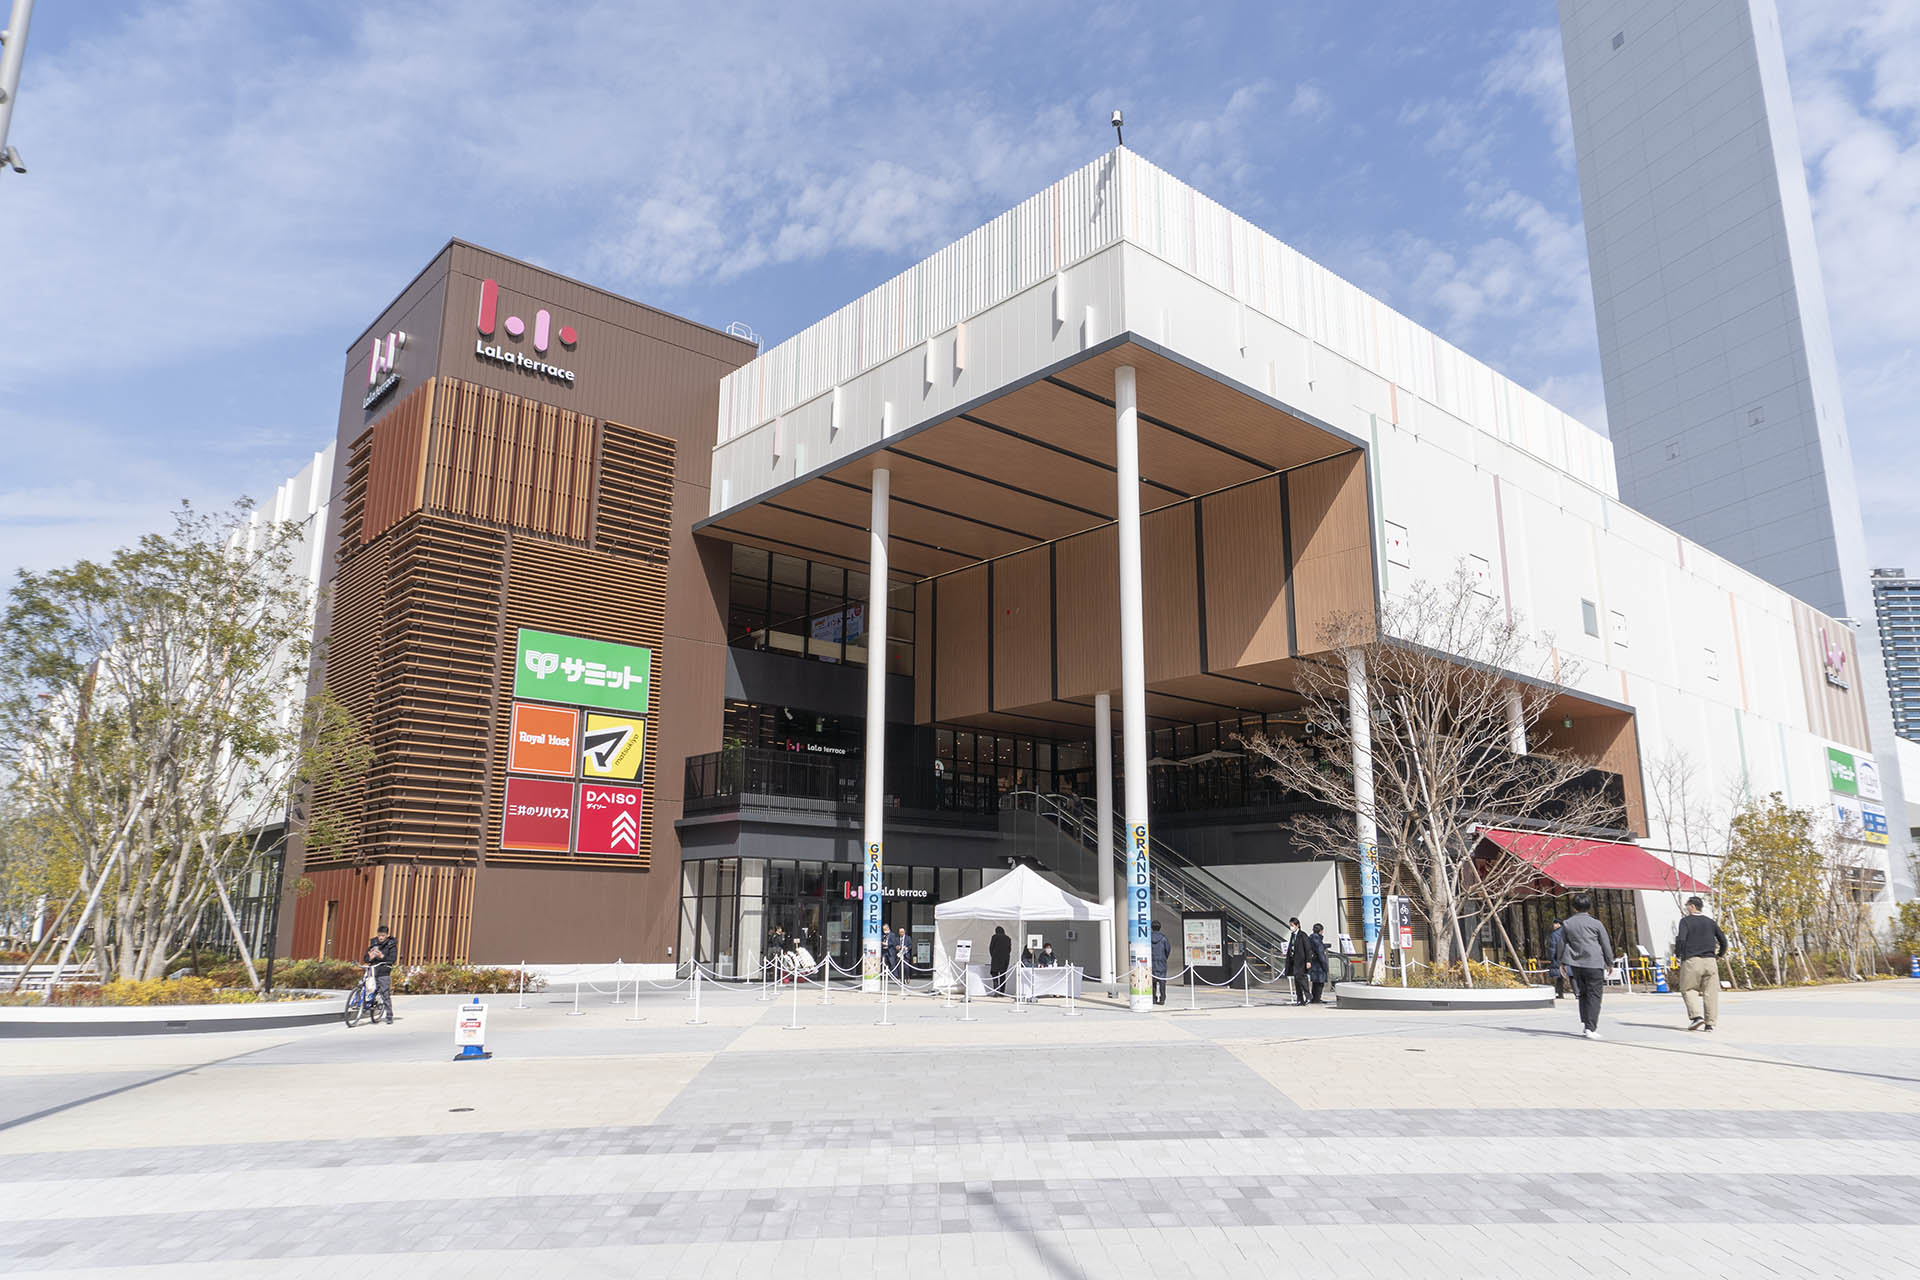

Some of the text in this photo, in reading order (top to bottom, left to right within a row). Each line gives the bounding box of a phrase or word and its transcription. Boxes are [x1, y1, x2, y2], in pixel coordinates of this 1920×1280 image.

[476, 340, 575, 381] LaLa terrace
[560, 656, 643, 690] サミット
[519, 731, 570, 747] Royal Host
[615, 734, 639, 766] matsukiyo
[807, 743, 846, 755] LaLa terrace
[586, 791, 637, 805] DAISO
[508, 804, 569, 819] 三井のリハウス
[869, 843, 879, 934] GRAND OPEN
[897, 887, 928, 898] terrace
[1135, 825, 1148, 938] GRAND OPEN
